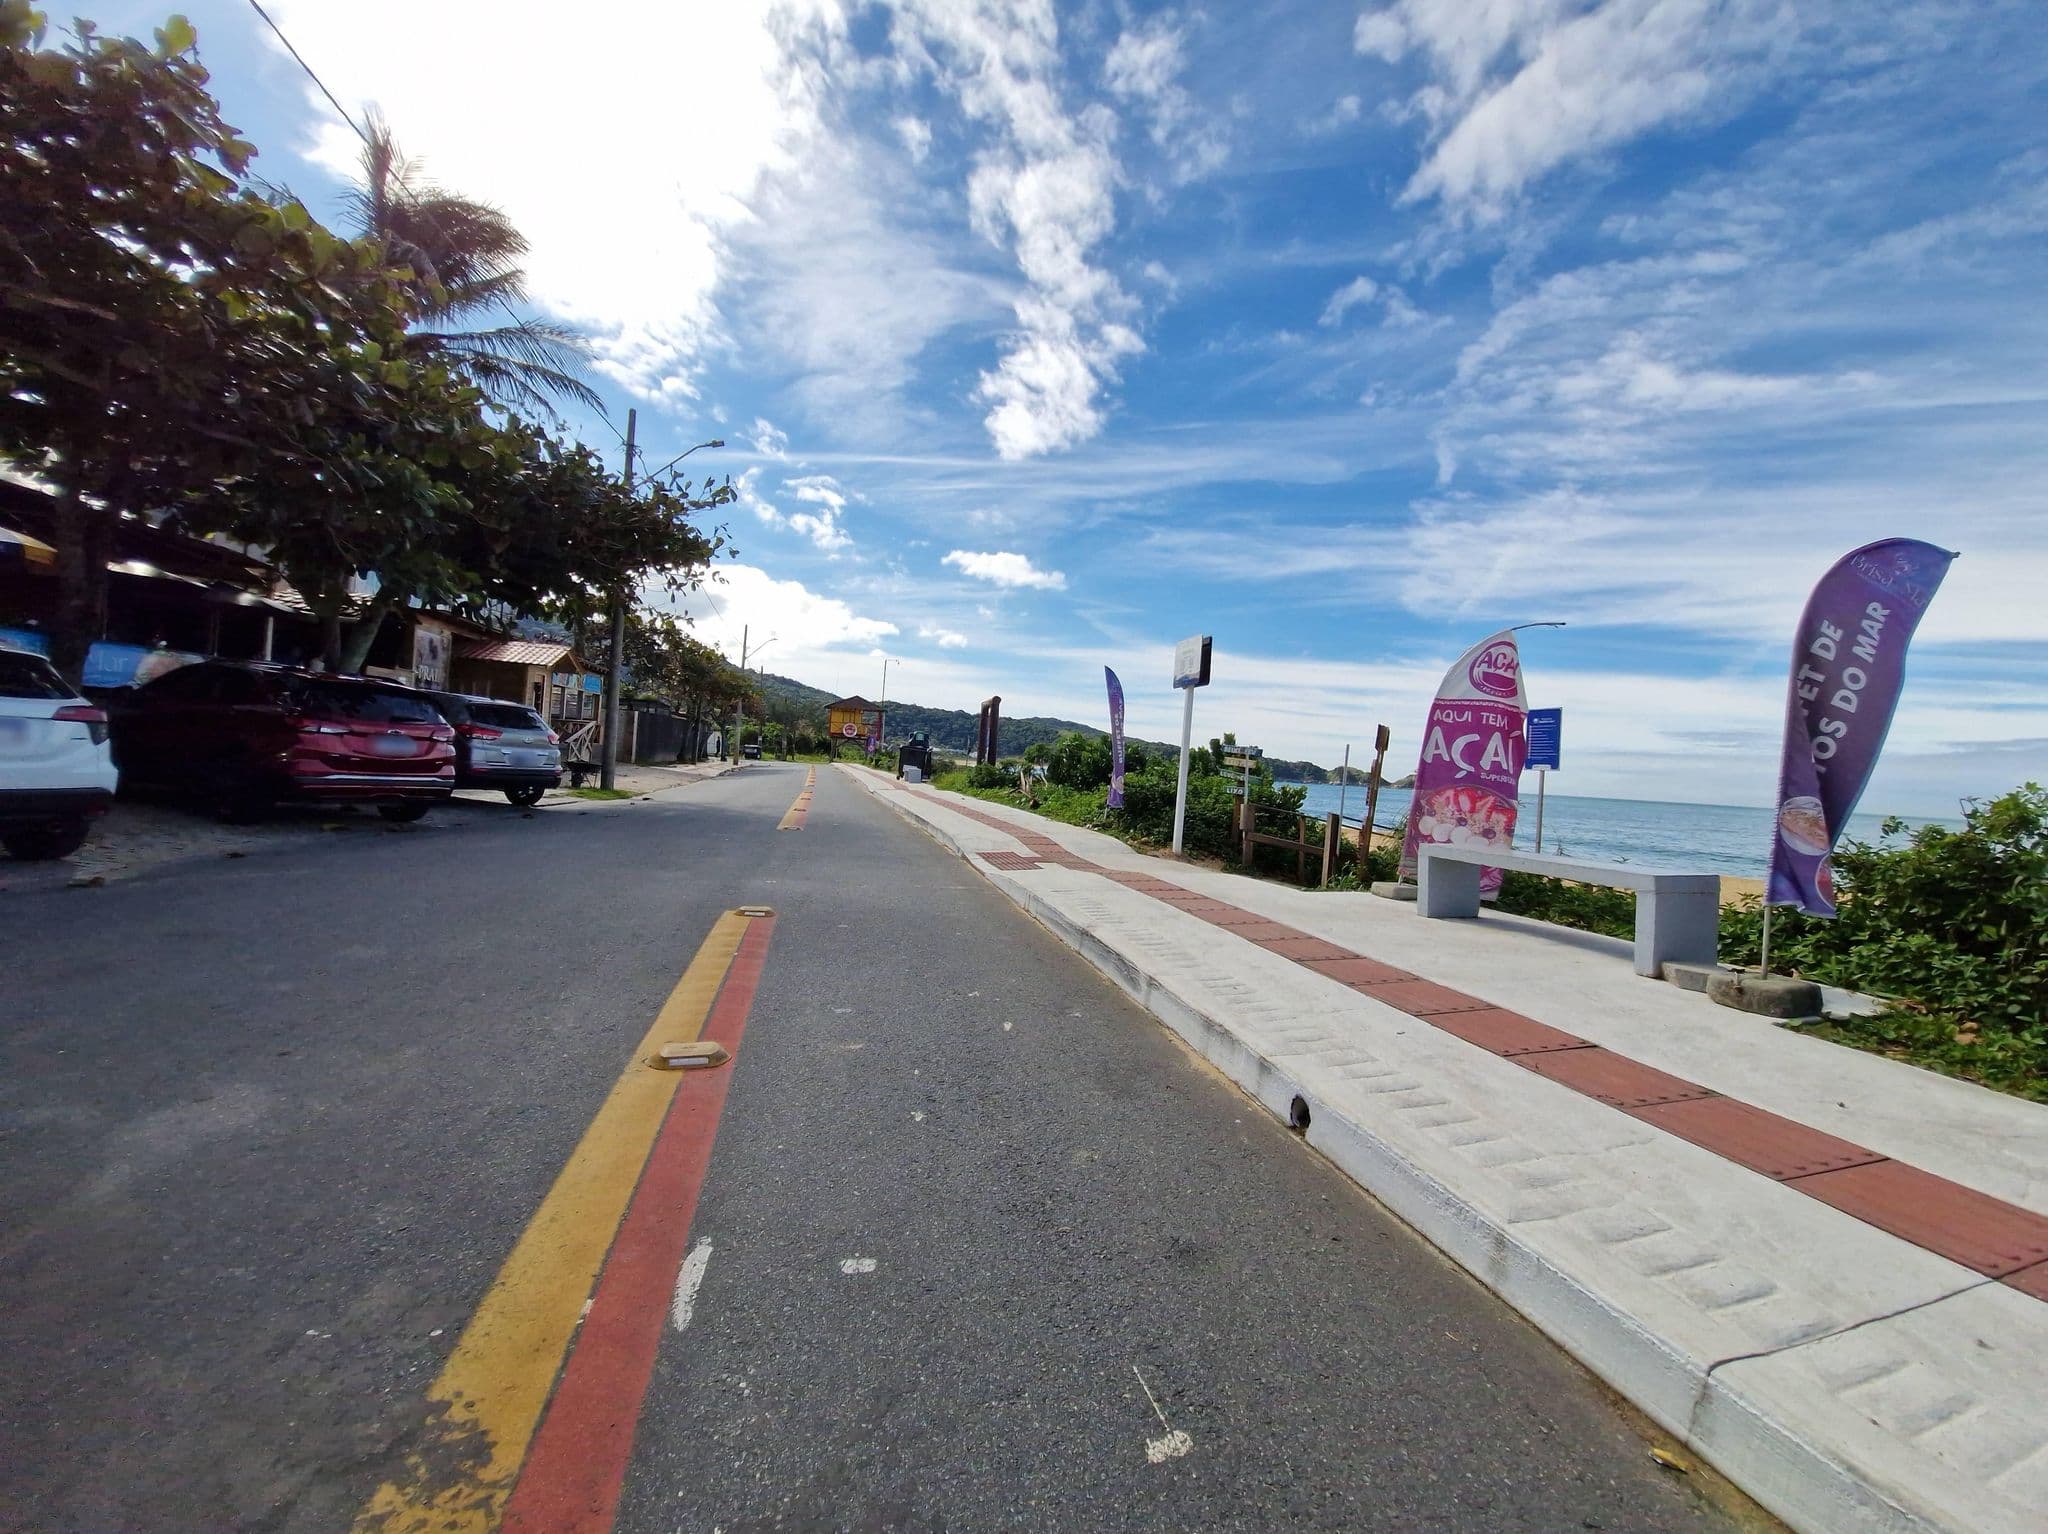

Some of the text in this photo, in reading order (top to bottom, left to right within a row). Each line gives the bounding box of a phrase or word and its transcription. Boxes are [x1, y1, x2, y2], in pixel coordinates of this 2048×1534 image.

[1810, 619, 1844, 661] DE
[1831, 666, 1866, 714] DO
[1852, 601, 1891, 664] MAR
[1433, 709, 1509, 731] AQUI TEM
[1423, 725, 1522, 779] AÇAÍ
